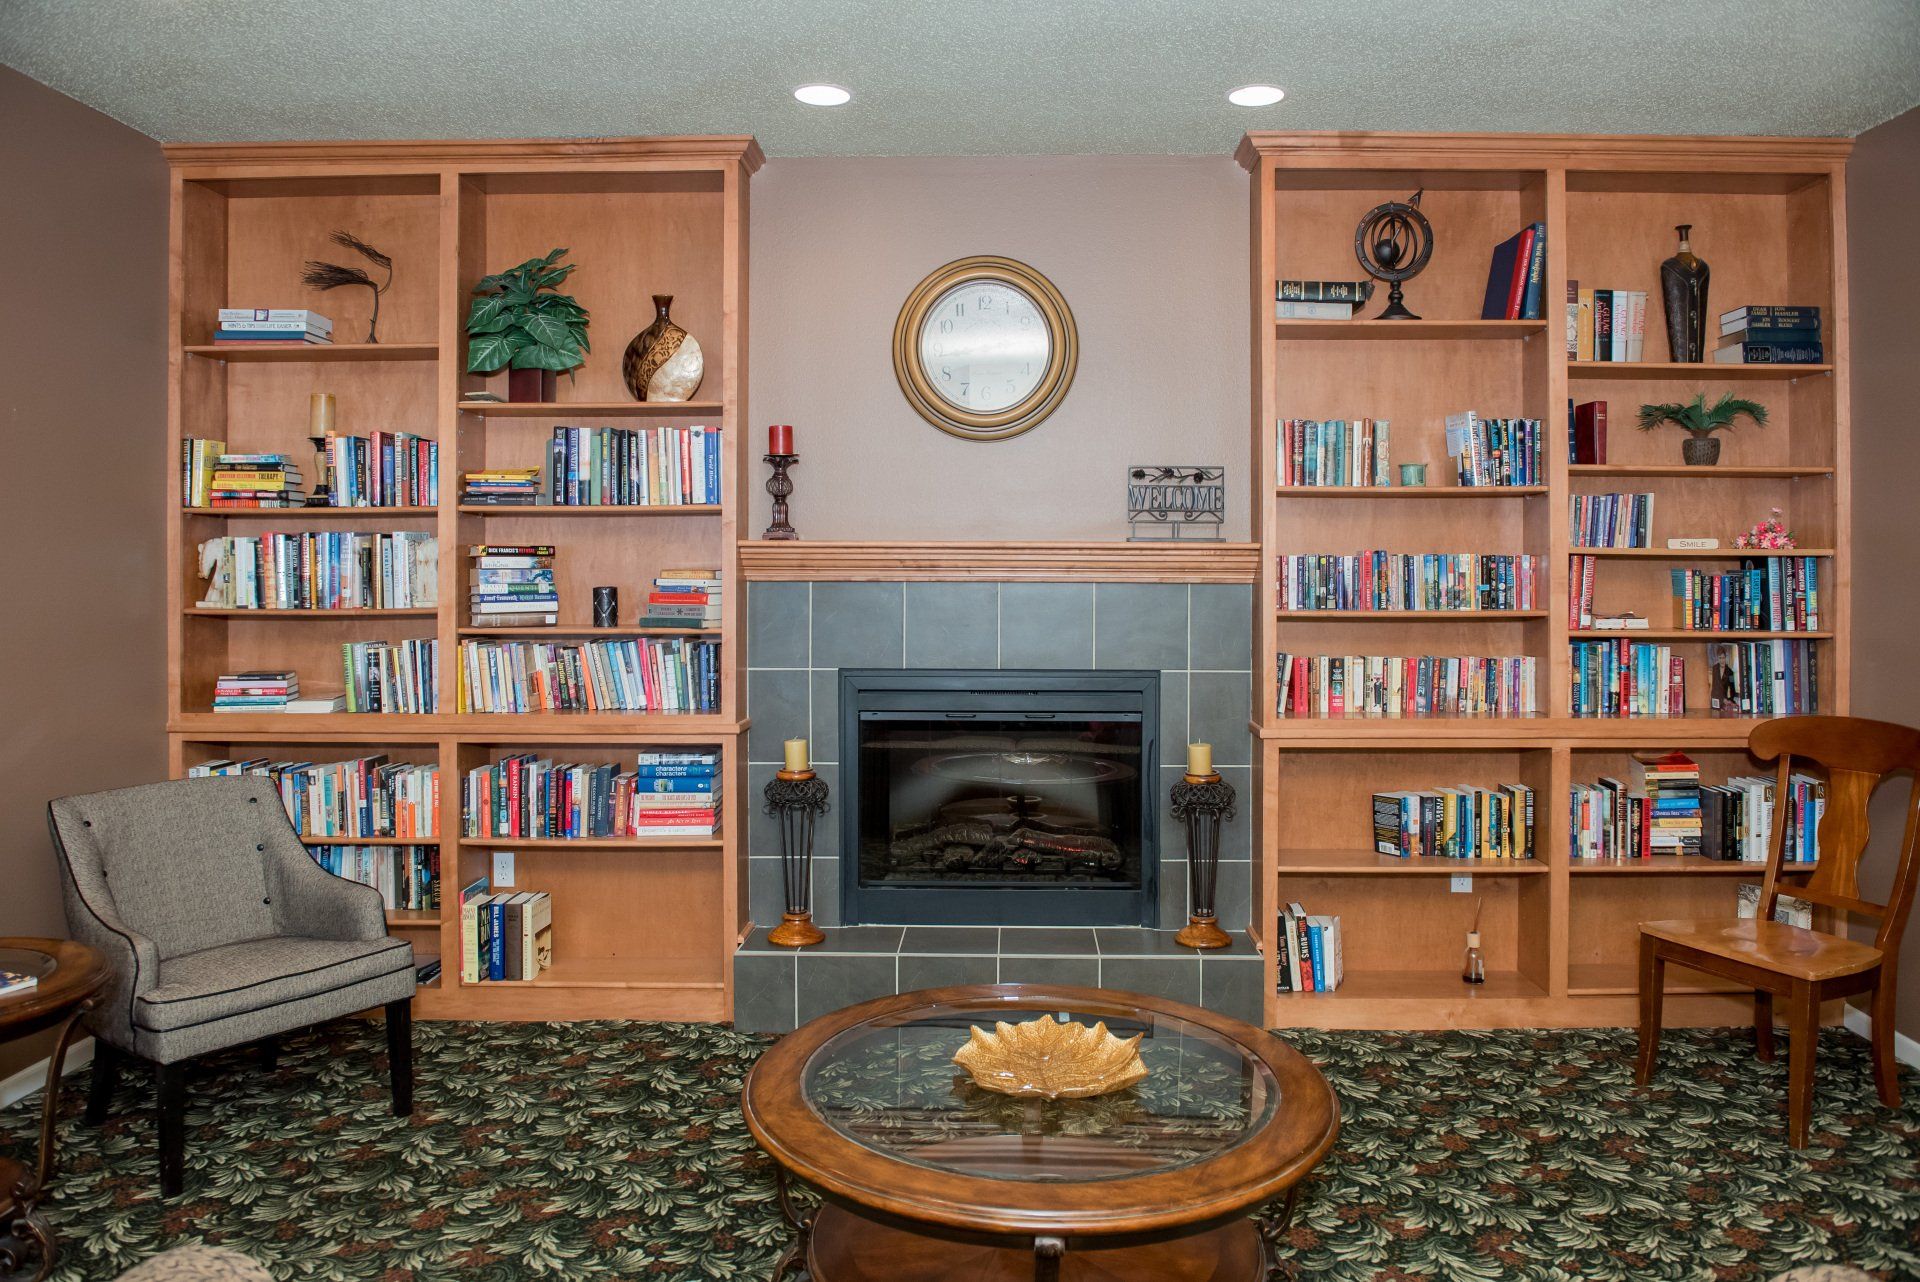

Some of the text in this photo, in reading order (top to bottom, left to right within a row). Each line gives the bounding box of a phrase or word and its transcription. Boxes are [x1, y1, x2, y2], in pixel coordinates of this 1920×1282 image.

[1530, 241, 1544, 285] World Geography
[955, 303, 965, 317] 11
[978, 296, 993, 310] 12
[940, 319, 954, 334] 10
[1595, 300, 1603, 334] Archipelago
[942, 366, 952, 381] 8
[960, 382, 970, 396] 7
[980, 387, 992, 401] 6
[1472, 425, 1480, 442] JANCE
[1129, 486, 1223, 511] WELCOME
[1583, 556, 1595, 609] DAVID BALDACCI
[1798, 568, 1806, 591] SANDFORD
[1526, 791, 1534, 826] STEVE MARTINI
[1619, 788, 1627, 823] THE JUDGE
[1280, 948, 1288, 967] Clancy
[1300, 937, 1310, 959] RUINS
